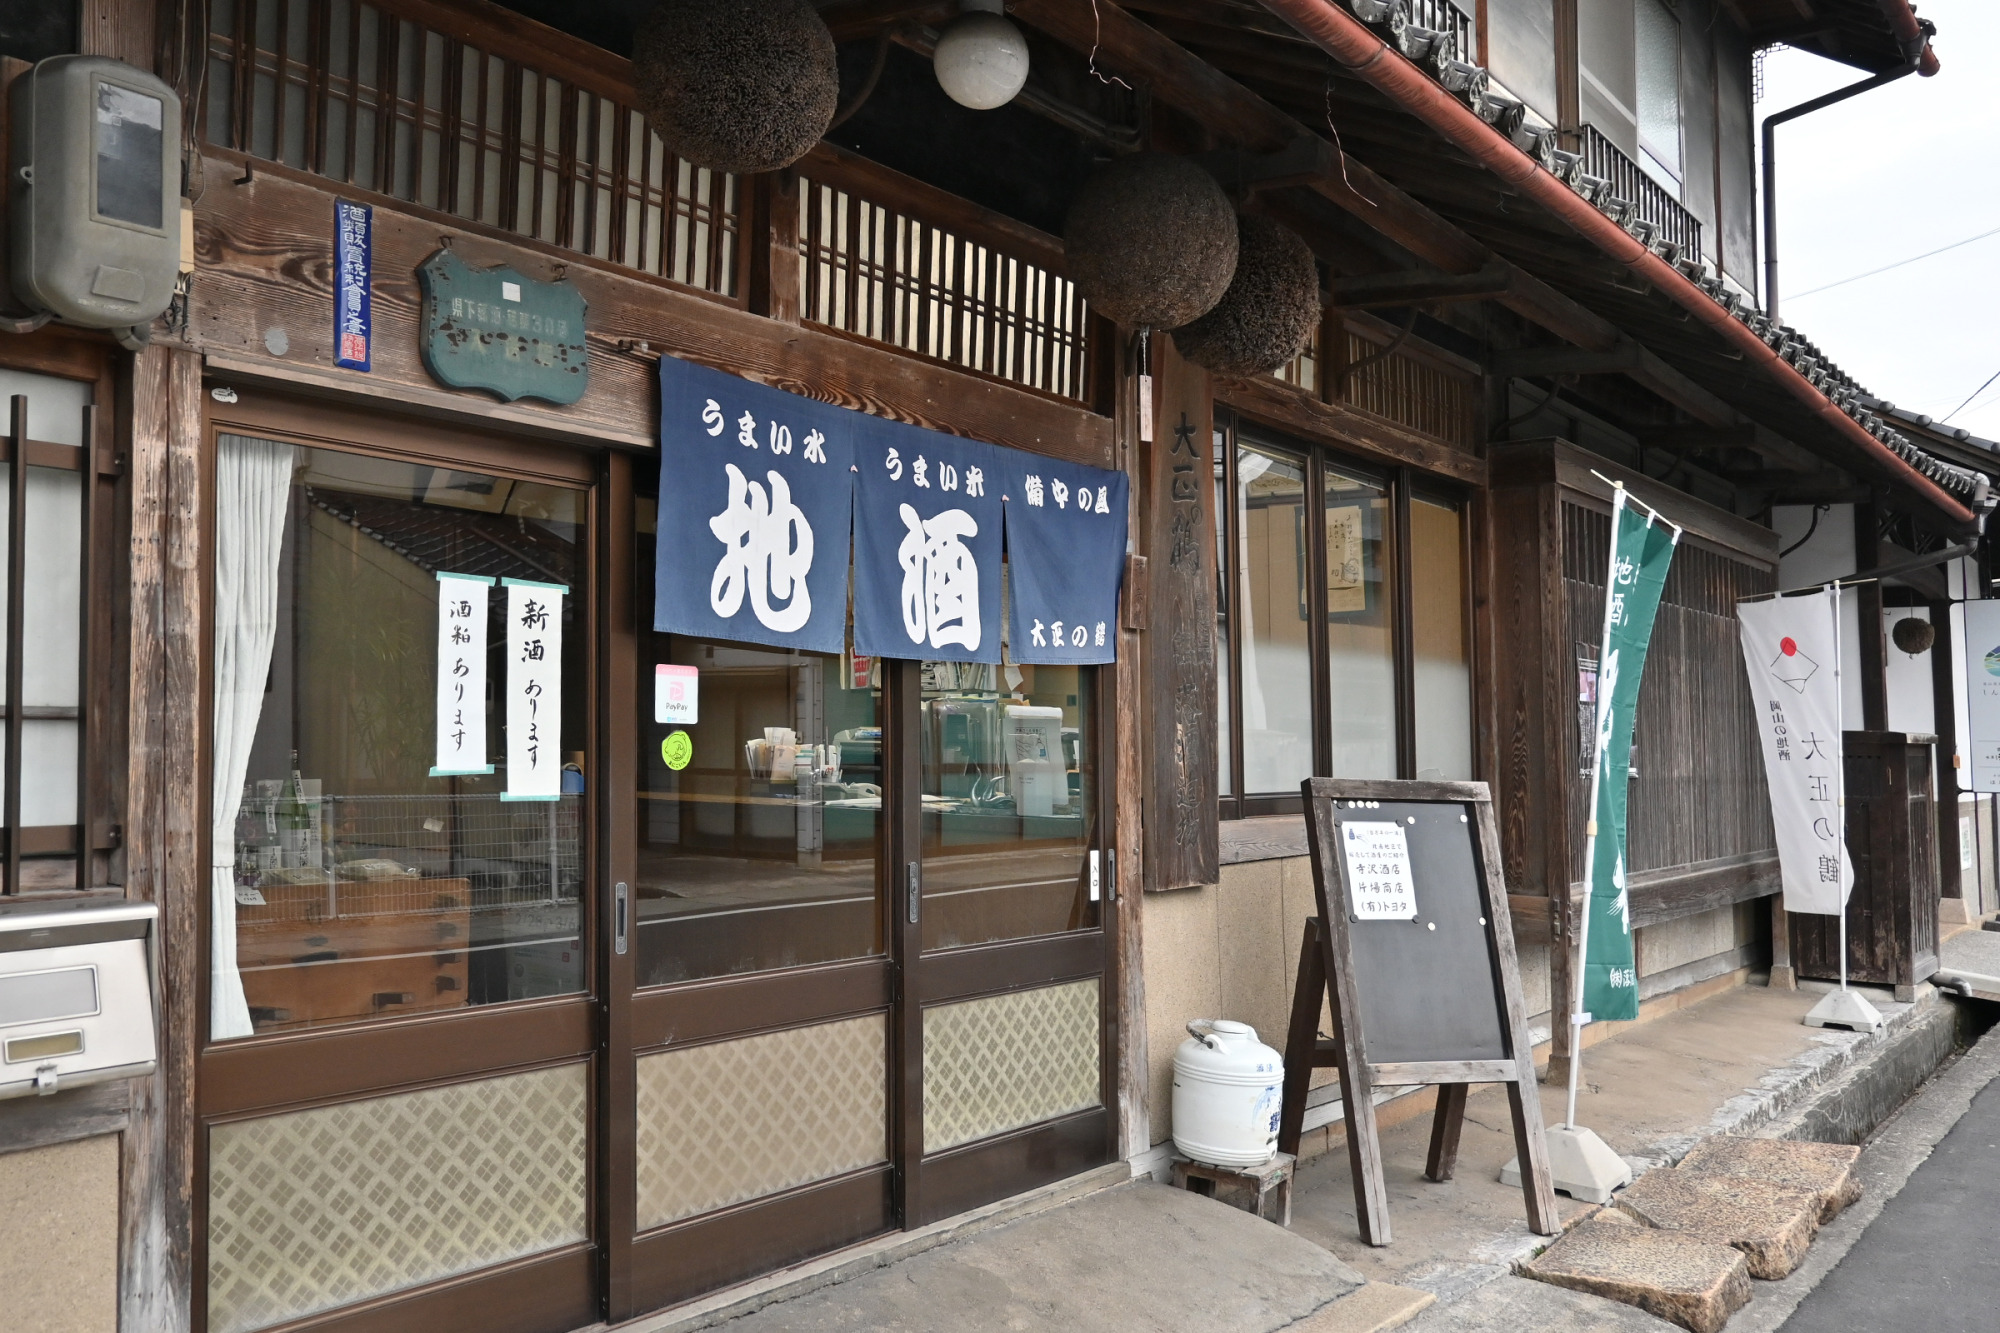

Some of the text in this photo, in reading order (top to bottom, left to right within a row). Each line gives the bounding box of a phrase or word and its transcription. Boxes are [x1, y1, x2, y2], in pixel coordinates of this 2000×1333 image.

[702, 398, 826, 464] うまい水
[885, 447, 984, 498] うまい米
[1030, 618, 1106, 647] 大正の鶴
[450, 600, 472, 751] 酒粕あります
[521, 598, 550, 770] 新酒あります
[665, 702, 688, 712] PayPay
